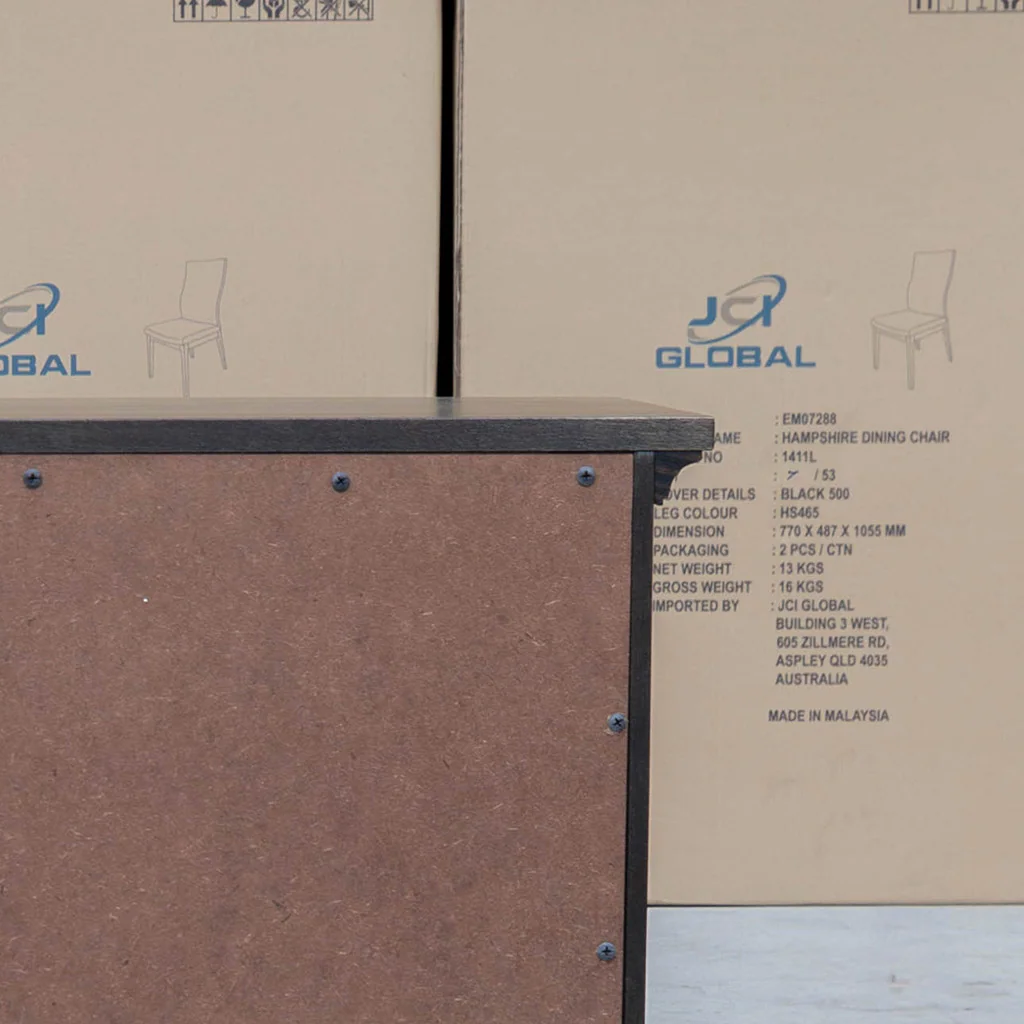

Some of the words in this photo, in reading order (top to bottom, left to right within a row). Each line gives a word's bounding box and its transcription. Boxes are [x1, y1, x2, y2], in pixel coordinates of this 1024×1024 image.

[655, 345, 817, 369] GLOBAL
[782, 412, 837, 425] EM07288
[714, 432, 741, 444] AME
[782, 431, 858, 444] HAMPSHIRE
[862, 431, 906, 444] DINING
[910, 431, 950, 443] CHAIR
[704, 451, 723, 463] NO
[782, 450, 817, 462] 1411L
[822, 468, 836, 481] 53
[666, 488, 699, 500] OVER
[702, 488, 756, 500] DETAILS
[781, 487, 825, 500] BLACK
[829, 487, 850, 500] 500
[654, 507, 679, 519] LEG
[683, 507, 738, 519] COLOUR
[780, 506, 819, 519] HS465
[653, 525, 725, 538] DIMENSION
[779, 525, 801, 537] 770
[804, 525, 813, 537] X
[816, 525, 837, 537] 487
[841, 525, 849, 537] X
[854, 524, 881, 537] 1055
[885, 524, 906, 536] MM
[653, 544, 729, 556] PACKAGING
[779, 544, 787, 556] 2
[790, 543, 816, 556] PCS
[827, 543, 853, 556] CTN
[652, 563, 678, 575] NET
[681, 562, 732, 575] WEIGHT
[779, 563, 793, 575] 13
[796, 562, 824, 575] KGS
[652, 581, 697, 594] GROSS
[701, 581, 752, 594] WEIGHT
[779, 581, 793, 593] 16
[796, 581, 824, 593] KGS
[652, 600, 718, 612] IMPORTED
[722, 600, 739, 612] BY
[778, 600, 798, 612] JCI
[801, 599, 854, 612] GLOBAL
[775, 618, 836, 630] BUILDING
[840, 618, 847, 630] 3
[850, 617, 889, 632] WEST,
[777, 636, 798, 649] 605
[801, 636, 864, 649] ZILLMERE
[868, 636, 890, 650] RD,
[775, 655, 825, 667] ASPLEY
[829, 655, 856, 668] QLD
[860, 654, 888, 667] 4035
[775, 673, 848, 686] AUSTRALIA
[768, 710, 805, 722] MADE
[809, 710, 821, 722] IN
[825, 710, 889, 722] MALAYSIA
